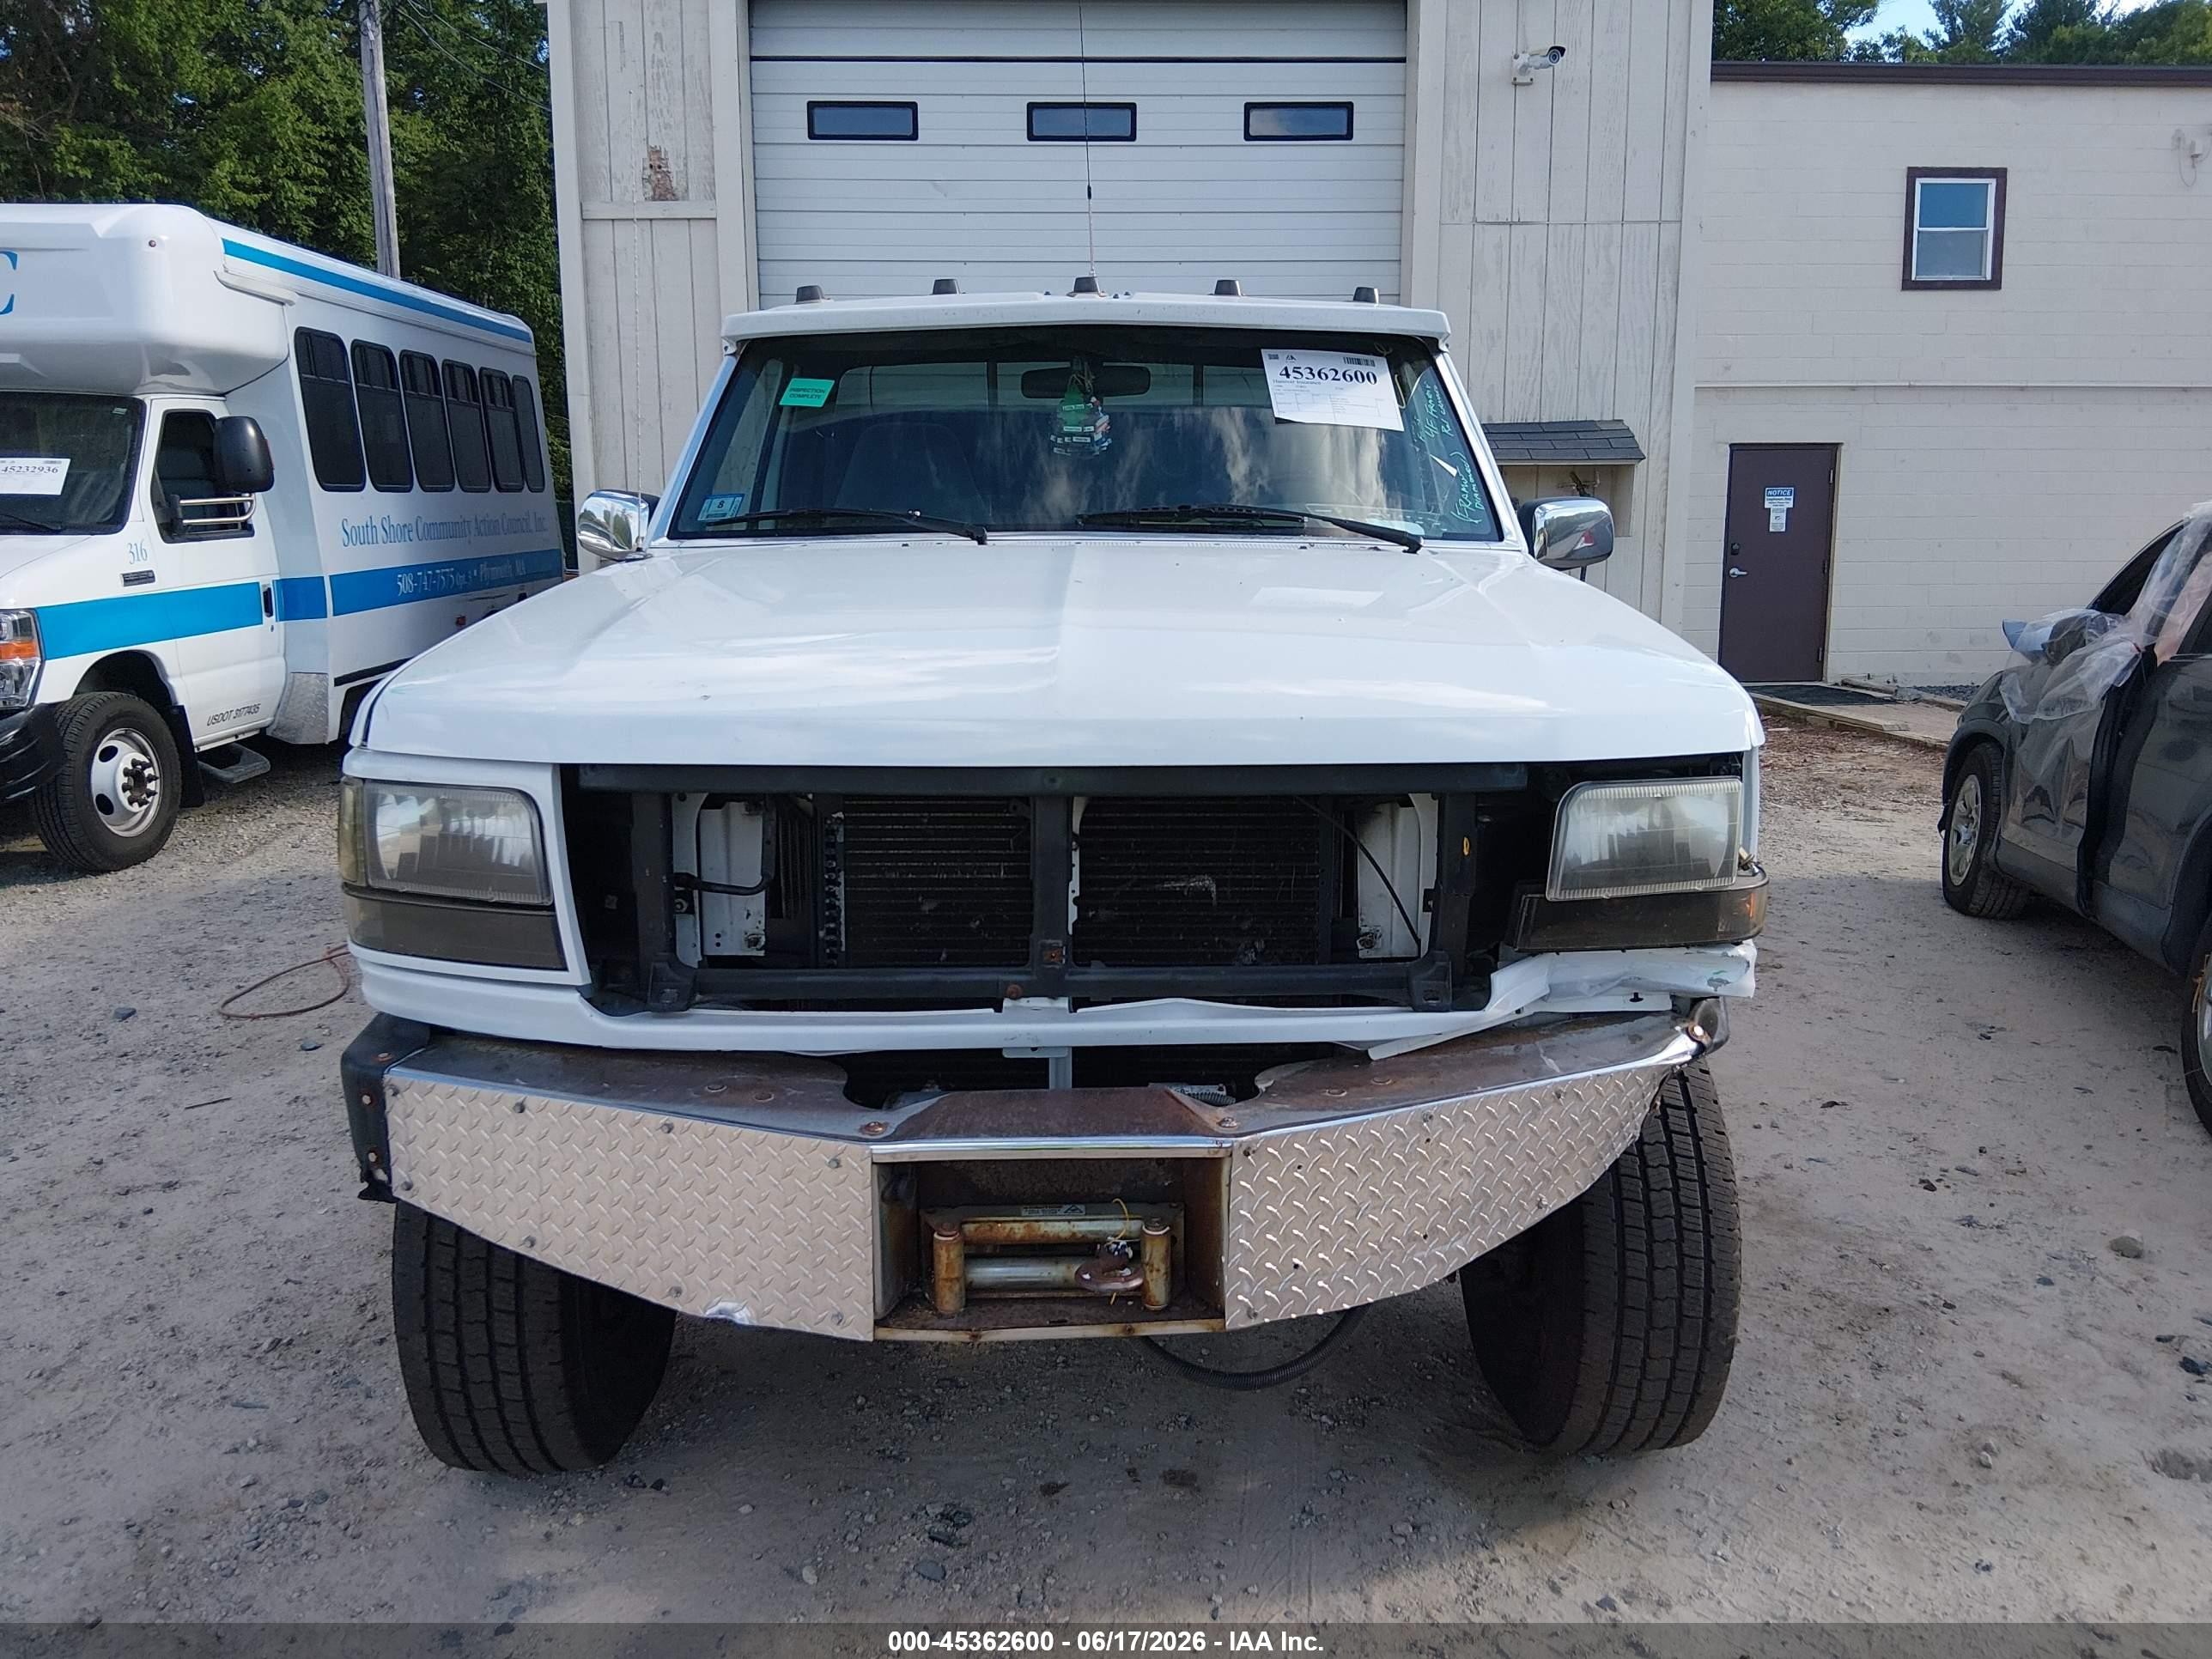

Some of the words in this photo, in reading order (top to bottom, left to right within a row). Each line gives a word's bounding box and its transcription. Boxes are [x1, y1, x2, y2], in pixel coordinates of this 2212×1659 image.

[1279, 366, 1377, 385] 45362600
[2, 465, 58, 474] 45232936
[717, 500, 725, 508] 8
[341, 516, 379, 548] South
[381, 515, 413, 544] Shore
[416, 515, 471, 544] Community
[473, 514, 501, 538] Action
[127, 538, 148, 565] 316
[397, 568, 455, 596] 508-747-7575
[207, 709, 234, 726] USDOT
